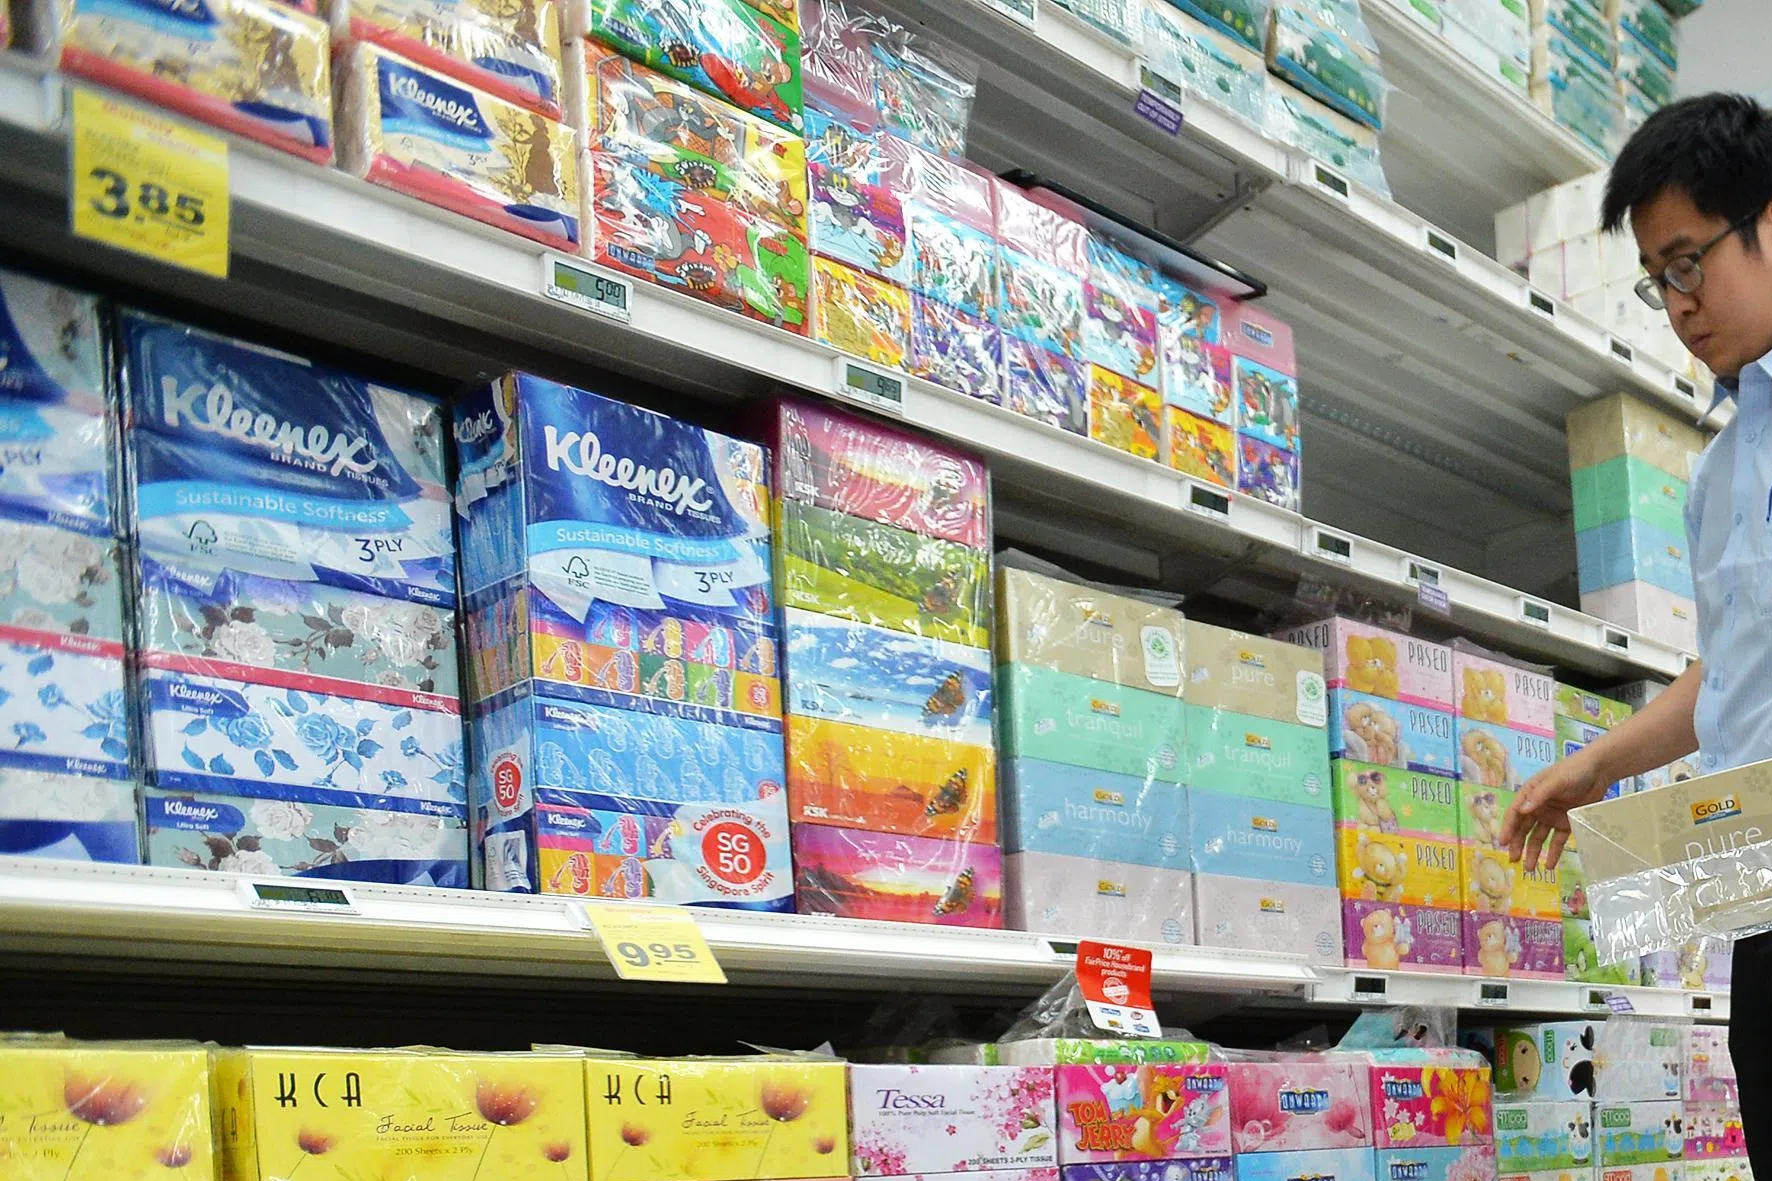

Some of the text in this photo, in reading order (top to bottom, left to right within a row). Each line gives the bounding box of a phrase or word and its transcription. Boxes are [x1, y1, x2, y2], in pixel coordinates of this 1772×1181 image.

[389, 72, 477, 126] Kleenex
[90, 168, 205, 225] 3.85
[160, 375, 379, 476] Kleenex
[270, 450, 389, 488] BRAND TISSUES
[543, 425, 714, 514] Kleenex
[174, 487, 388, 525] Sustainable Softness
[629, 492, 722, 525] BRAND TISSUES
[556, 527, 721, 559] Sustainable Softness
[567, 577, 591, 590] FSC
[1408, 641, 1447, 672] PASEO
[1231, 665, 1274, 686] pure
[1515, 672, 1550, 702] PASEO
[169, 683, 223, 704] Kleenex
[1067, 709, 1143, 740] tranquil
[1410, 710, 1450, 740] PASEO
[1224, 744, 1291, 769] tranquil
[1517, 736, 1552, 764] PASEO
[1411, 777, 1452, 805] PASEO
[164, 800, 218, 818] Kleenex
[547, 812, 586, 829] Kleenex
[1065, 798, 1152, 833] harmony
[1694, 798, 1736, 818] GOLD
[692, 808, 772, 839] Celebrating the
[717, 833, 750, 853] SG
[1227, 825, 1303, 853] harmony
[1685, 824, 1763, 861] pure
[718, 854, 752, 876] 50
[1416, 844, 1455, 871] PASEO
[695, 865, 775, 897] Singapore Spirit
[1416, 908, 1456, 936] PASEO
[1524, 920, 1561, 945] PASEO
[617, 942, 697, 967] 9.95
[1085, 956, 1145, 972] FairPrice Housebrand
[1101, 969, 1127, 978] products
[274, 1072, 361, 1107] KCA
[604, 1074, 671, 1105] KCA
[876, 1089, 945, 1109] Tessa
[1281, 1090, 1329, 1112] ONWARDS
[376, 1112, 488, 1135] Facial Tissue
[1068, 1101, 1108, 1125] TOM
[395, 1148, 413, 1156] 200
[414, 1147, 443, 1156] Sheets
[459, 1146, 473, 1156] Ply
[1076, 1124, 1137, 1151] JERRY
